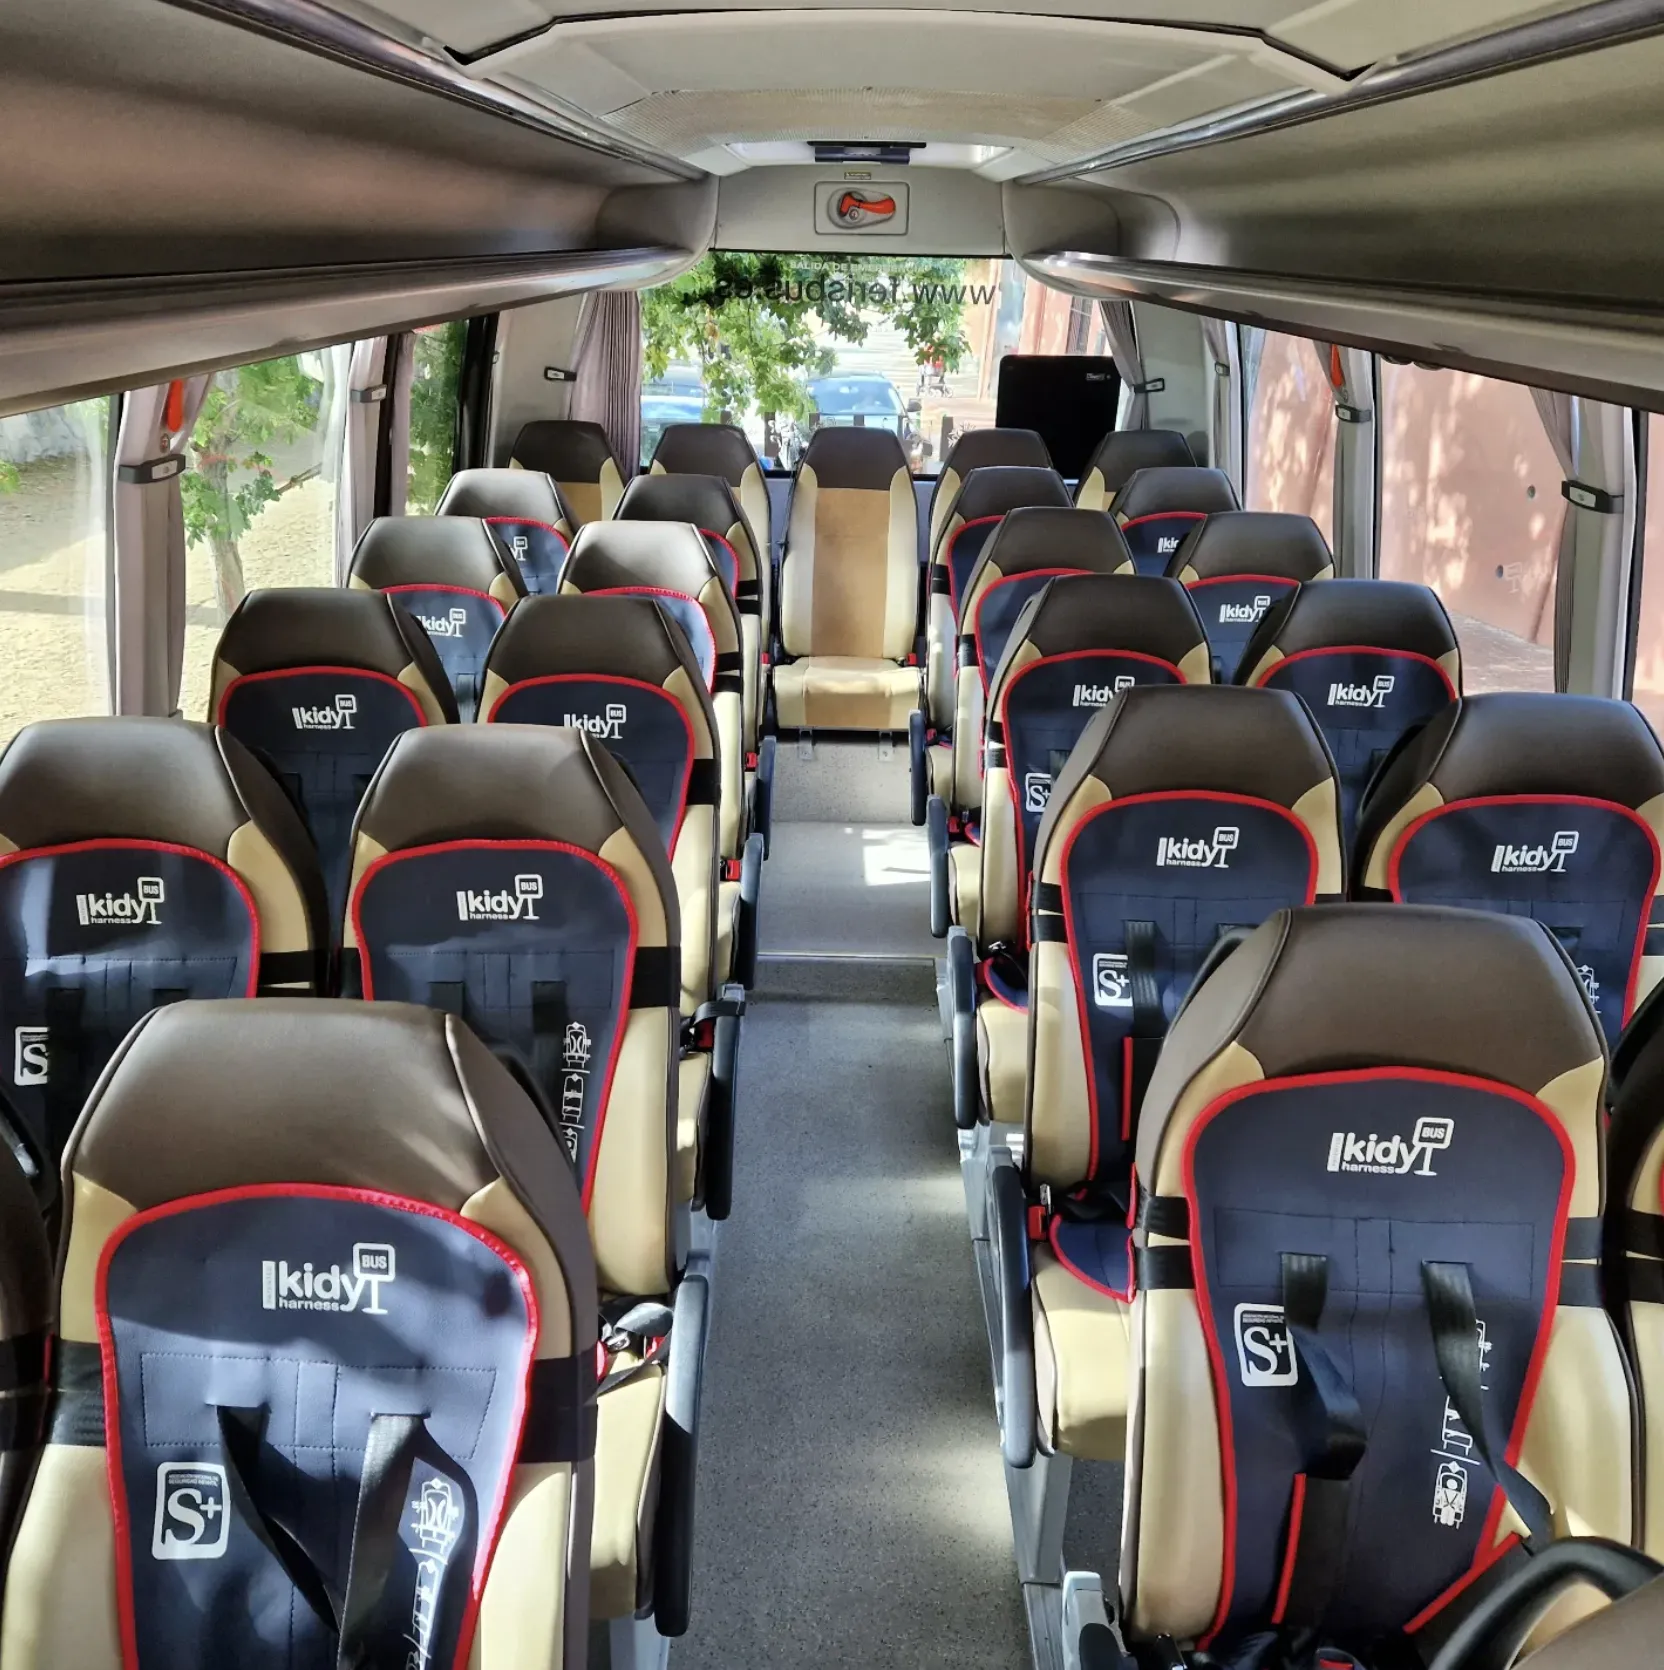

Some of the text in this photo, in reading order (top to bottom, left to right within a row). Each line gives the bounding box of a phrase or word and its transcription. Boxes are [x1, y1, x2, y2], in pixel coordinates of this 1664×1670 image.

[790, 261, 830, 271] SALIDA
[833, 263, 848, 272] DE
[1226, 604, 1259, 623] kidy
[1337, 683, 1378, 707] kidy
[300, 706, 344, 730] kidy
[571, 713, 613, 739] kidy
[1218, 833, 1234, 843] BUS
[1557, 838, 1574, 847] BUS
[1167, 837, 1219, 867] kidy
[1504, 845, 1558, 872] kidy
[143, 885, 160, 895] BUS
[520, 881, 538, 891] BUS
[88, 892, 147, 924] kidy
[467, 889, 524, 920] kidy
[23, 1043, 50, 1076] S
[1421, 1126, 1446, 1139] BUS
[1343, 1132, 1422, 1174] kidy
[1341, 1161, 1396, 1174] harness
[361, 1254, 388, 1270] BUS
[278, 1260, 366, 1313] kidy
[278, 1296, 341, 1312] harness
